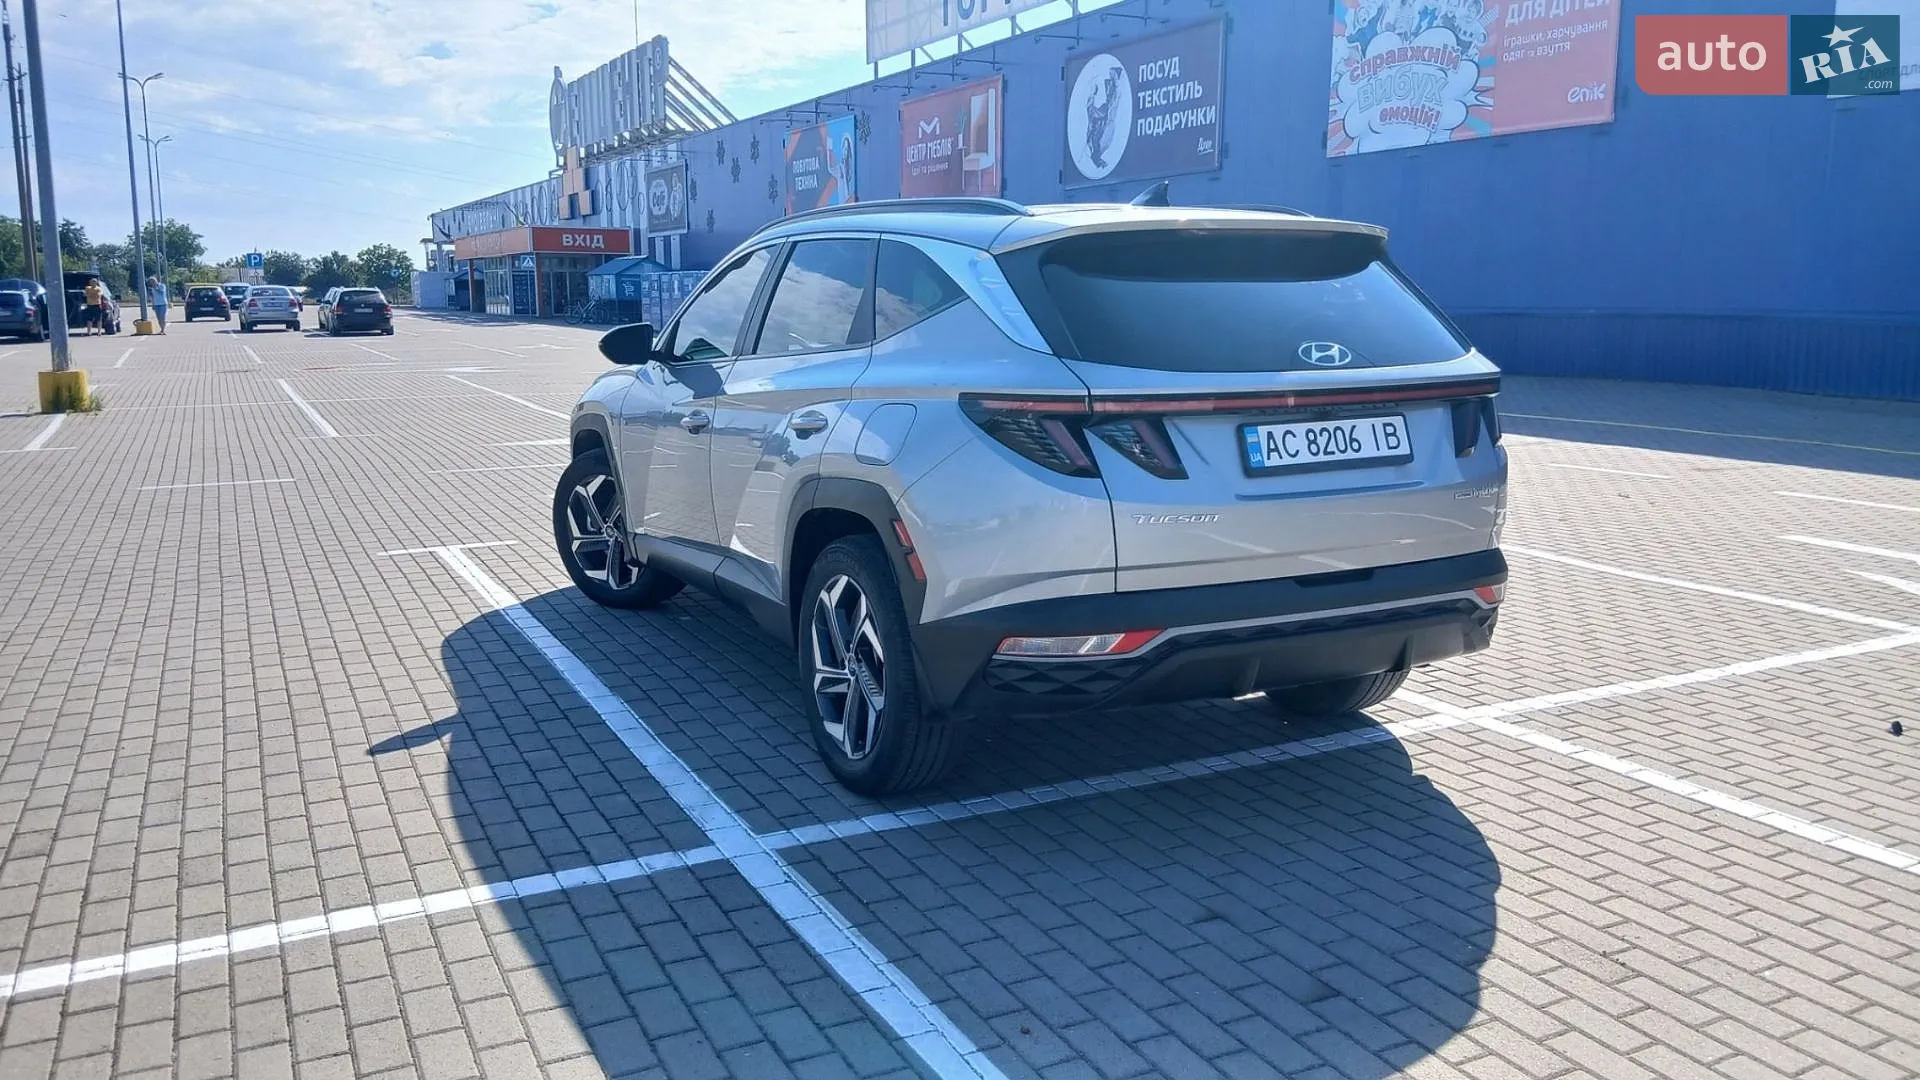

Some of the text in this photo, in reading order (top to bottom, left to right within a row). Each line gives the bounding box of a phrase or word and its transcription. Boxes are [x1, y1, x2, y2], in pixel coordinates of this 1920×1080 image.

[1547, 19, 1608, 41] харчування
[1537, 41, 1571, 56] взуття
[1139, 56, 1180, 83] ПОСУД
[1138, 80, 1203, 109] ТЕКСТИЛЬ
[1137, 105, 1216, 137] ПОДАРУНКИ
[906, 143, 927, 164] ЦЕНТР
[562, 234, 605, 249] ВХІД
[1266, 422, 1401, 461] AC 8206 IB
